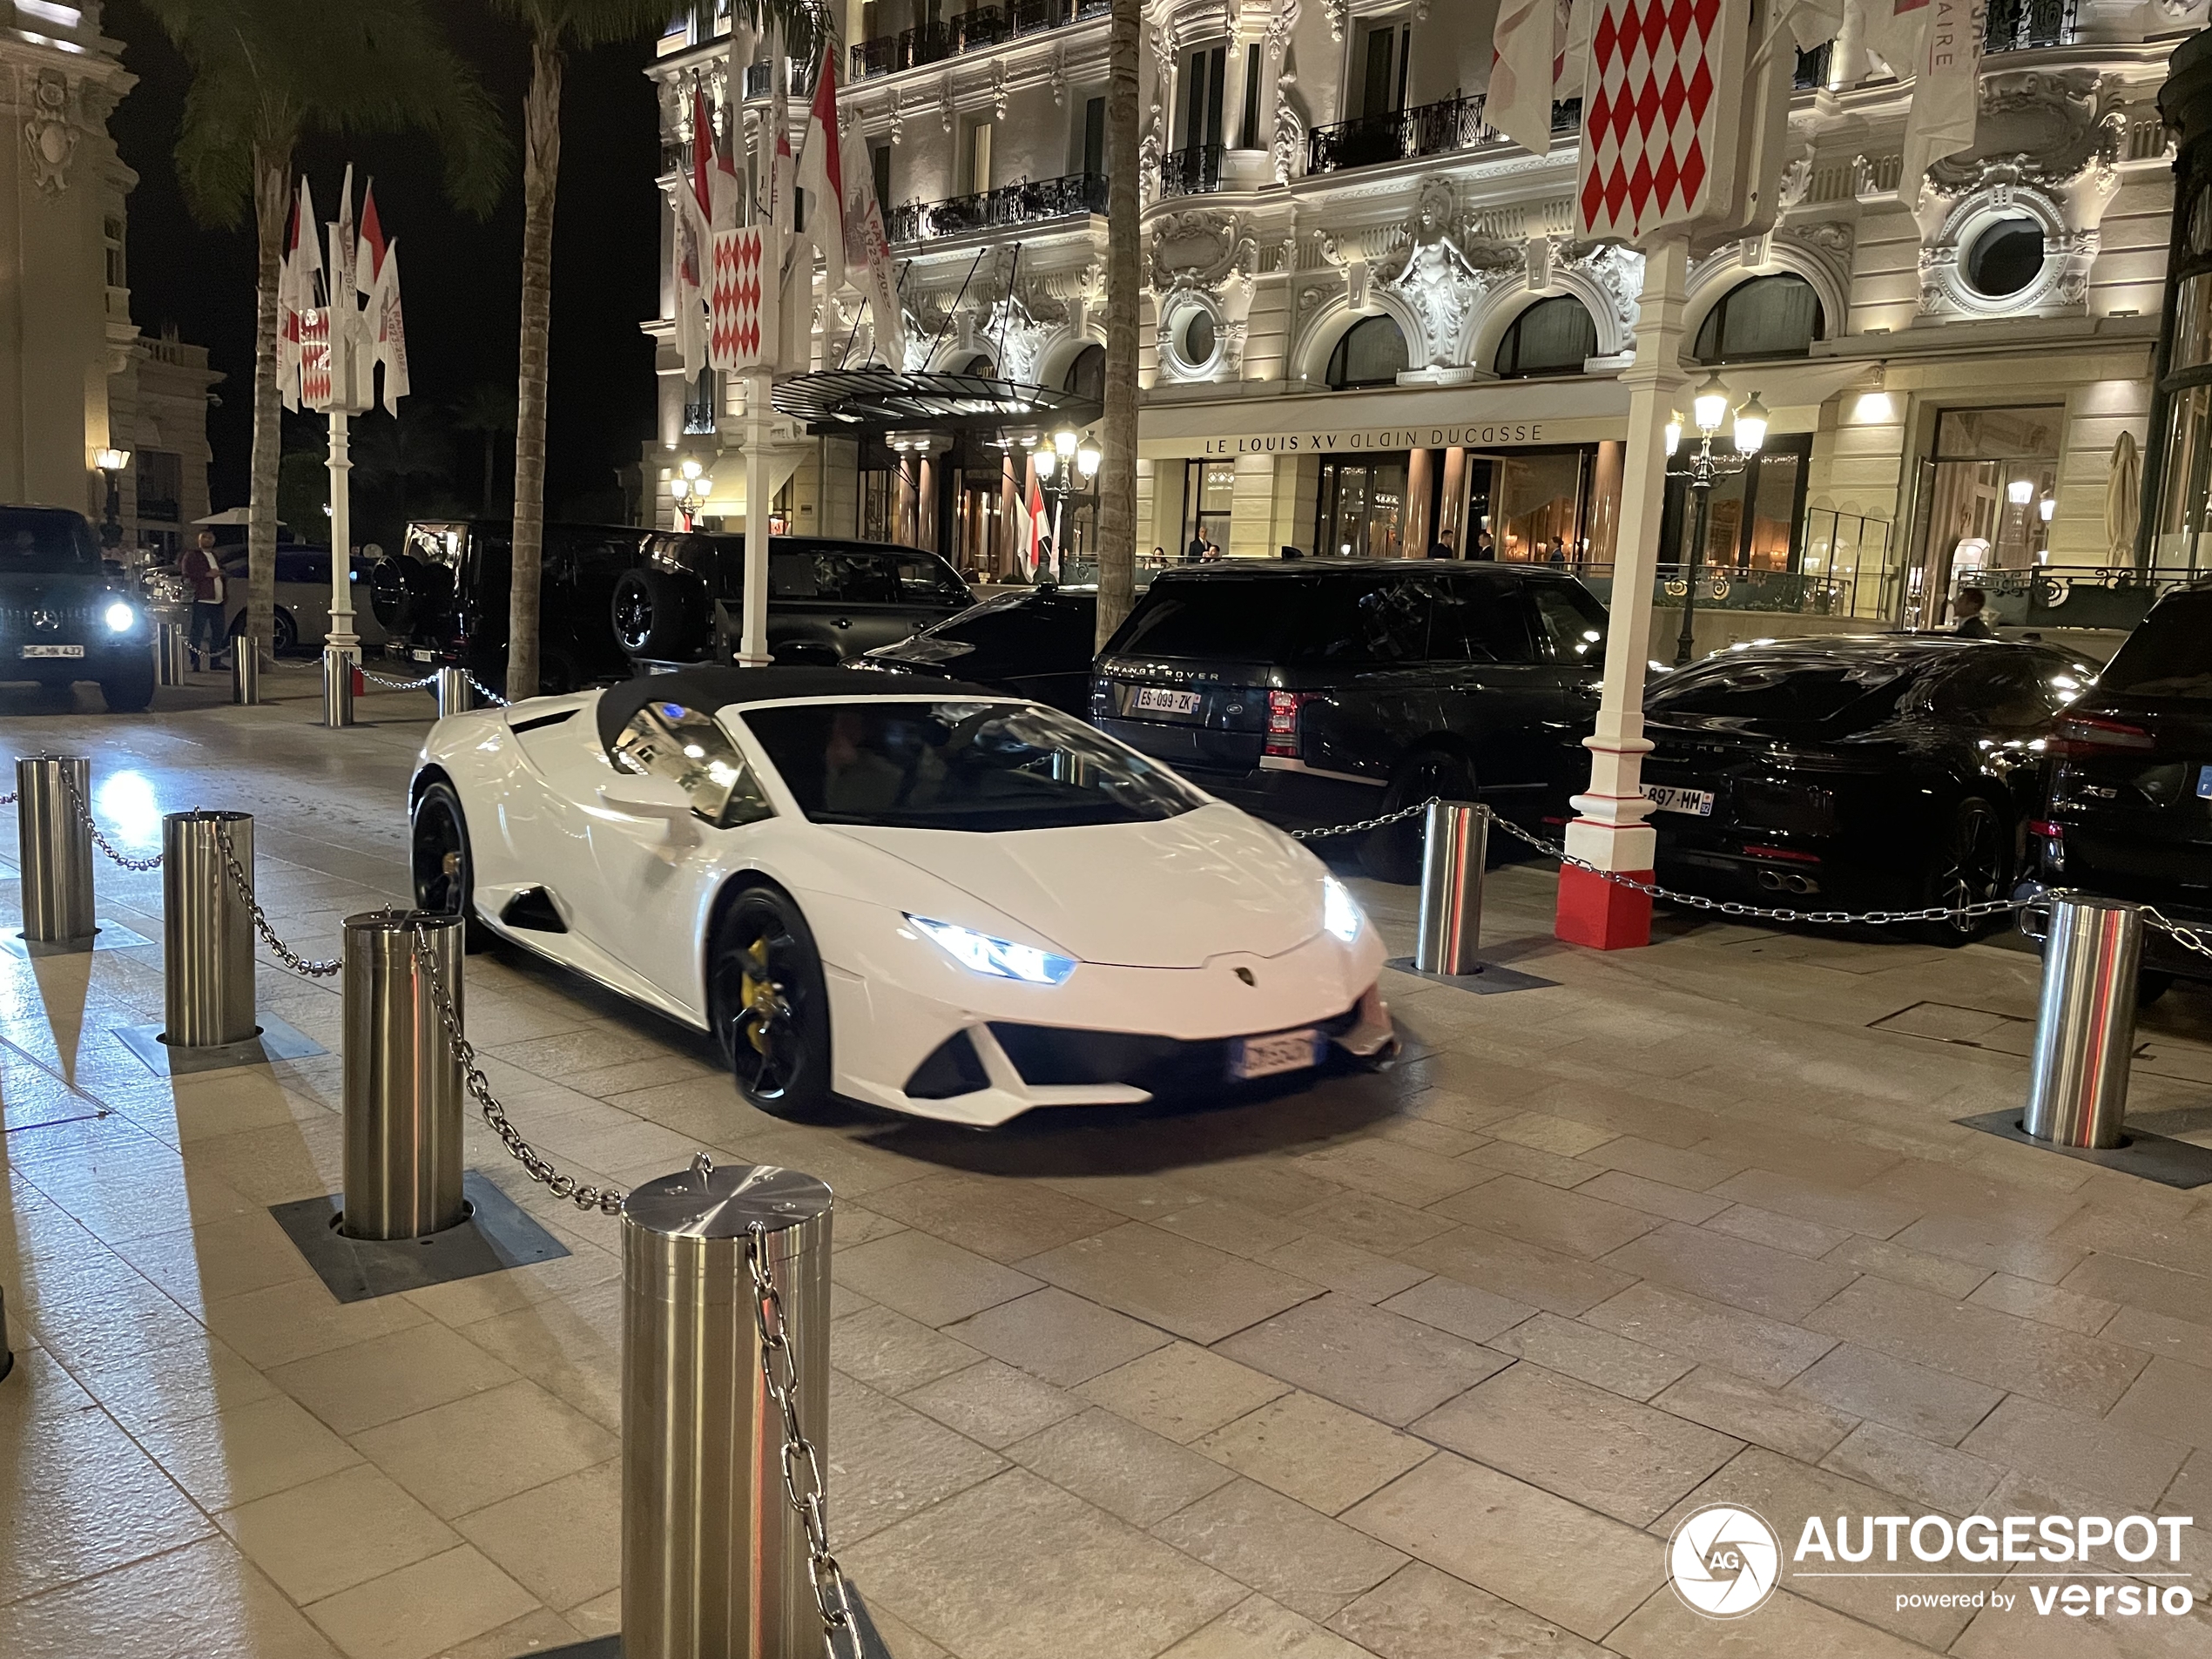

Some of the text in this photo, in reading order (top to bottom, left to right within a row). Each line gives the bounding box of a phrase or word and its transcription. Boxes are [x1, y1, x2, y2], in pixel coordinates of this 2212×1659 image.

[1206, 440, 1226, 453] LE
[1239, 436, 1298, 452] LOUIS
[1311, 435, 1338, 449] XV
[1113, 665, 1219, 680] RANGE ROVER
[1639, 786, 1701, 810] -897-MM
[1701, 803, 1710, 813] 92
